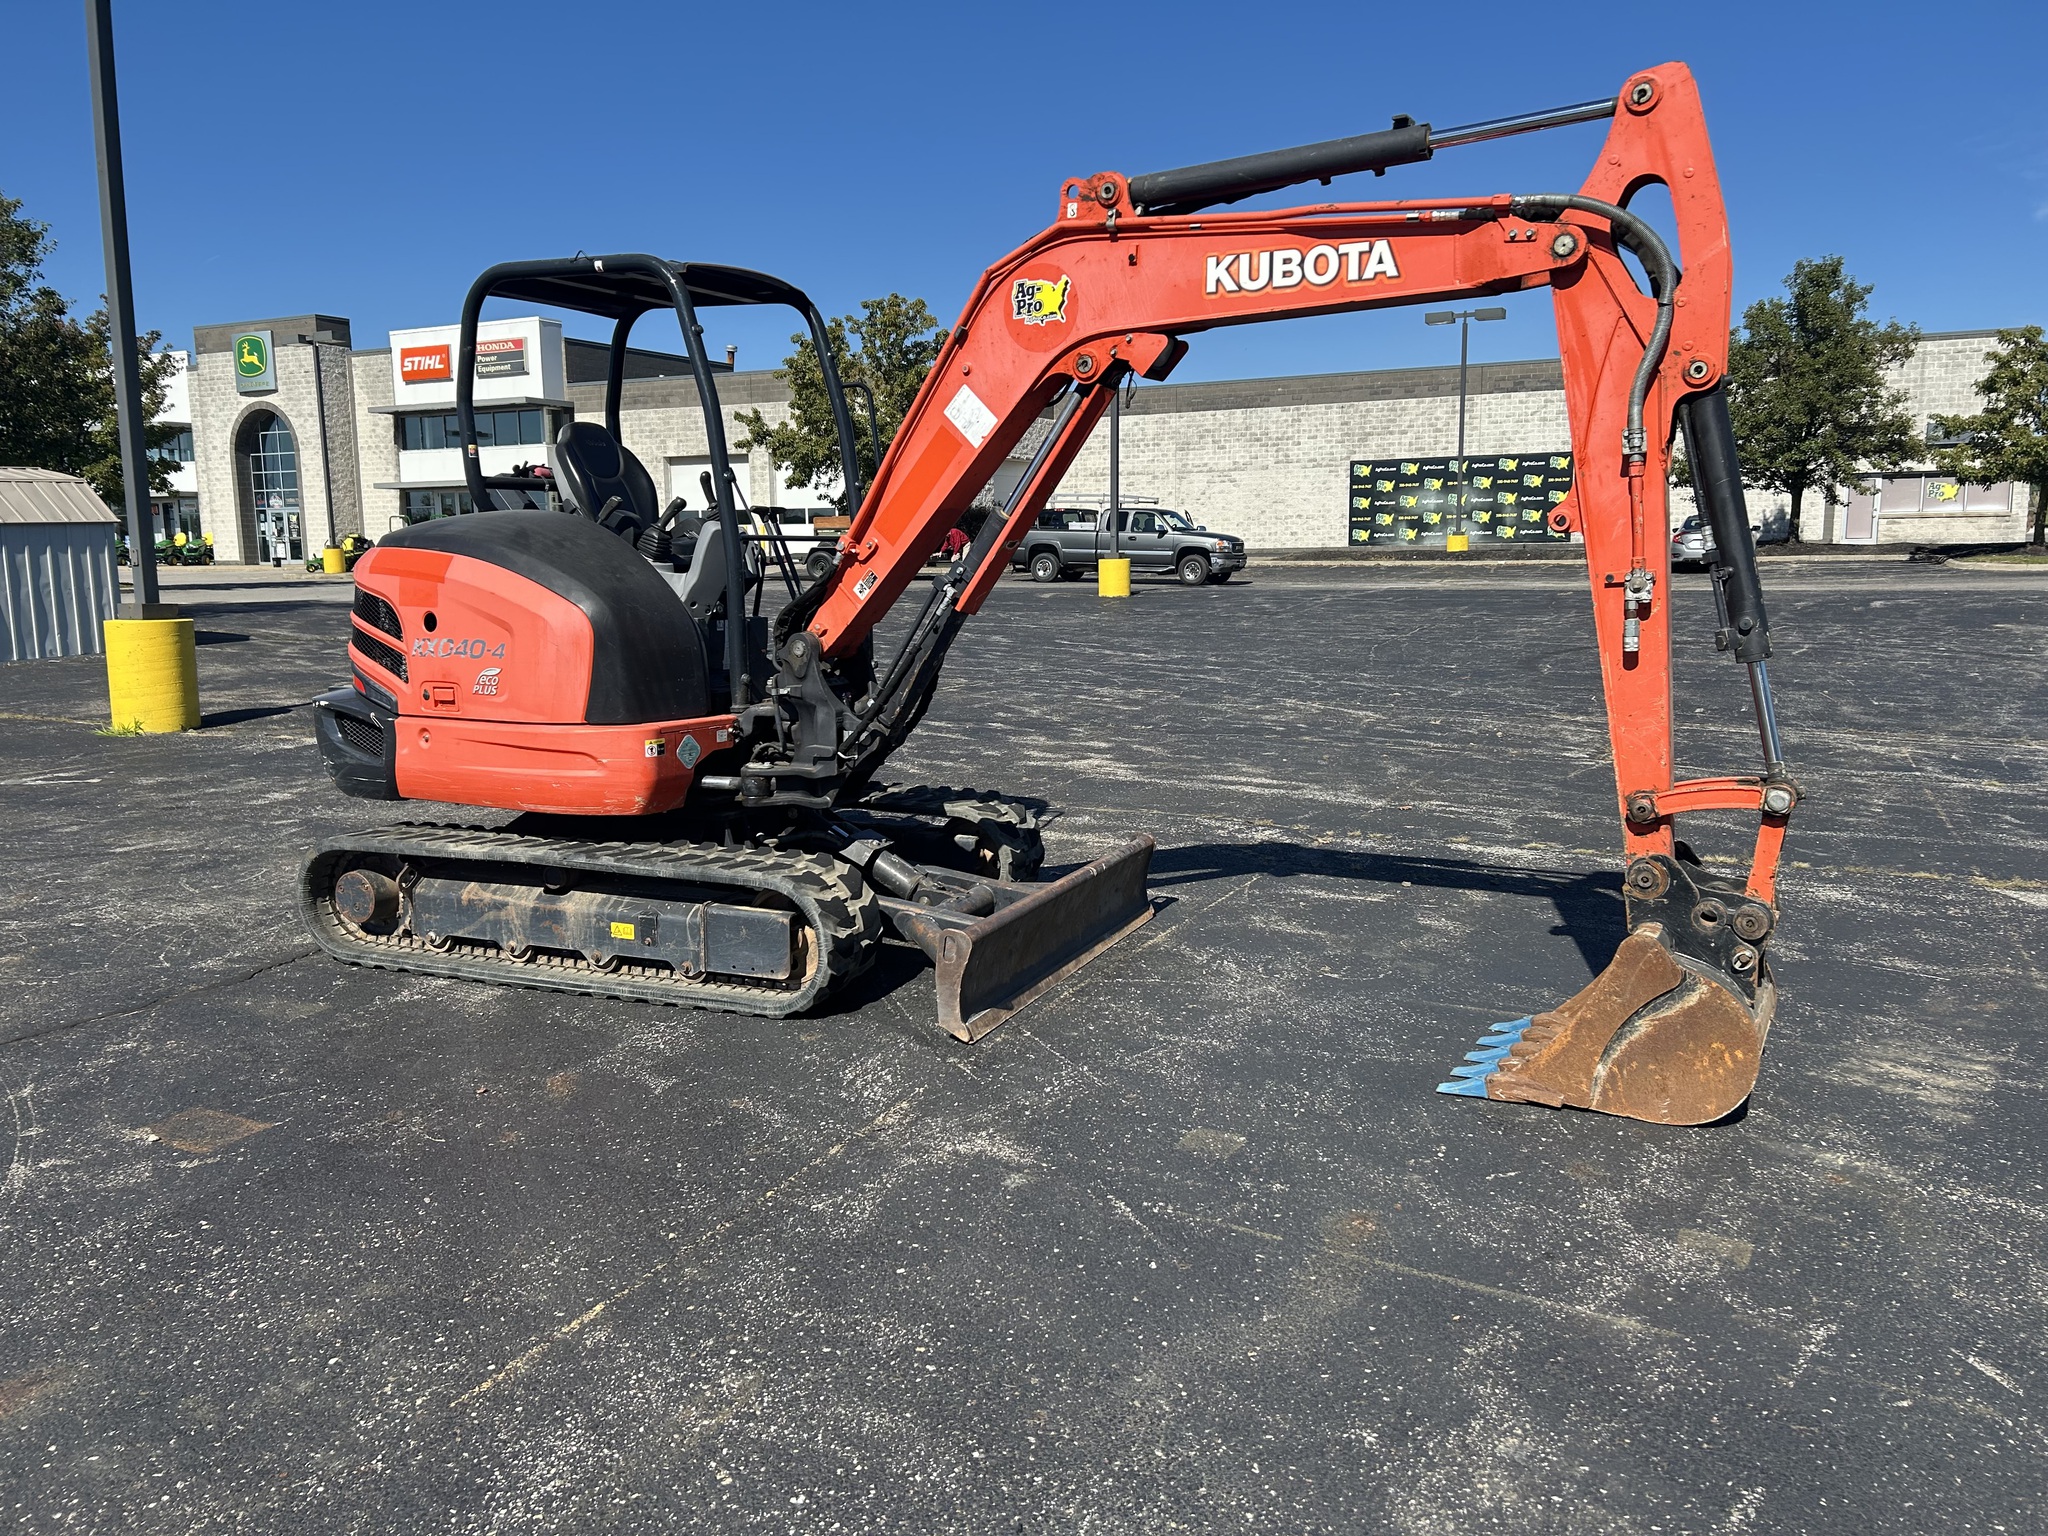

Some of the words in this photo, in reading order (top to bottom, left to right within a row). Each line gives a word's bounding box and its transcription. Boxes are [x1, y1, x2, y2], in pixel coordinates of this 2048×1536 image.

[1206, 239, 1399, 293] KUBOTA
[1015, 283, 1041, 300] Ag-
[1016, 299, 1043, 315] Pro
[477, 341, 515, 352] HONDA
[403, 354, 444, 372] STIHL
[477, 354, 498, 363] Power
[478, 364, 512, 374] Equipment
[412, 638, 506, 659] KX040-4
[479, 676, 498, 686] eco
[472, 685, 498, 695] PLUS
